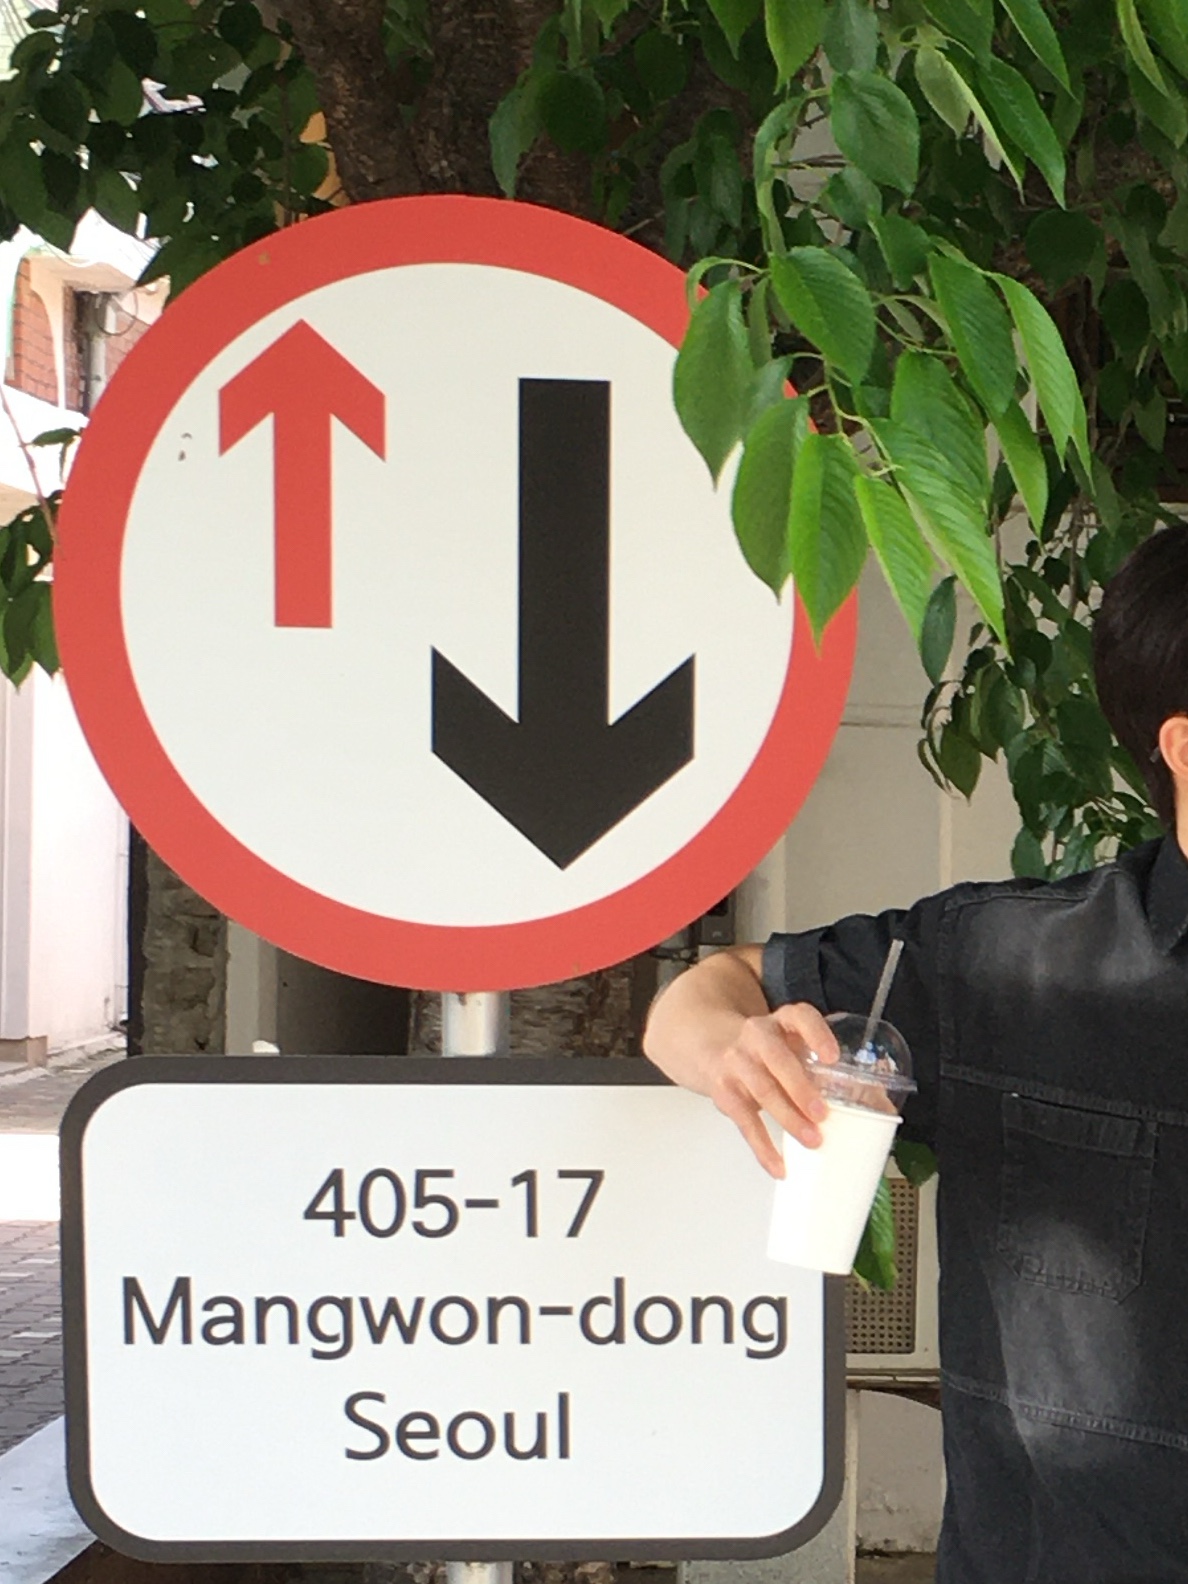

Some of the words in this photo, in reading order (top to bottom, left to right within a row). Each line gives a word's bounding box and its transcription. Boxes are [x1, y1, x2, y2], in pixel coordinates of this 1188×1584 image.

[303, 1167, 604, 1239] 405-17
[122, 1276, 788, 1361] Mangwon-dong
[343, 1390, 570, 1461] Seoul
